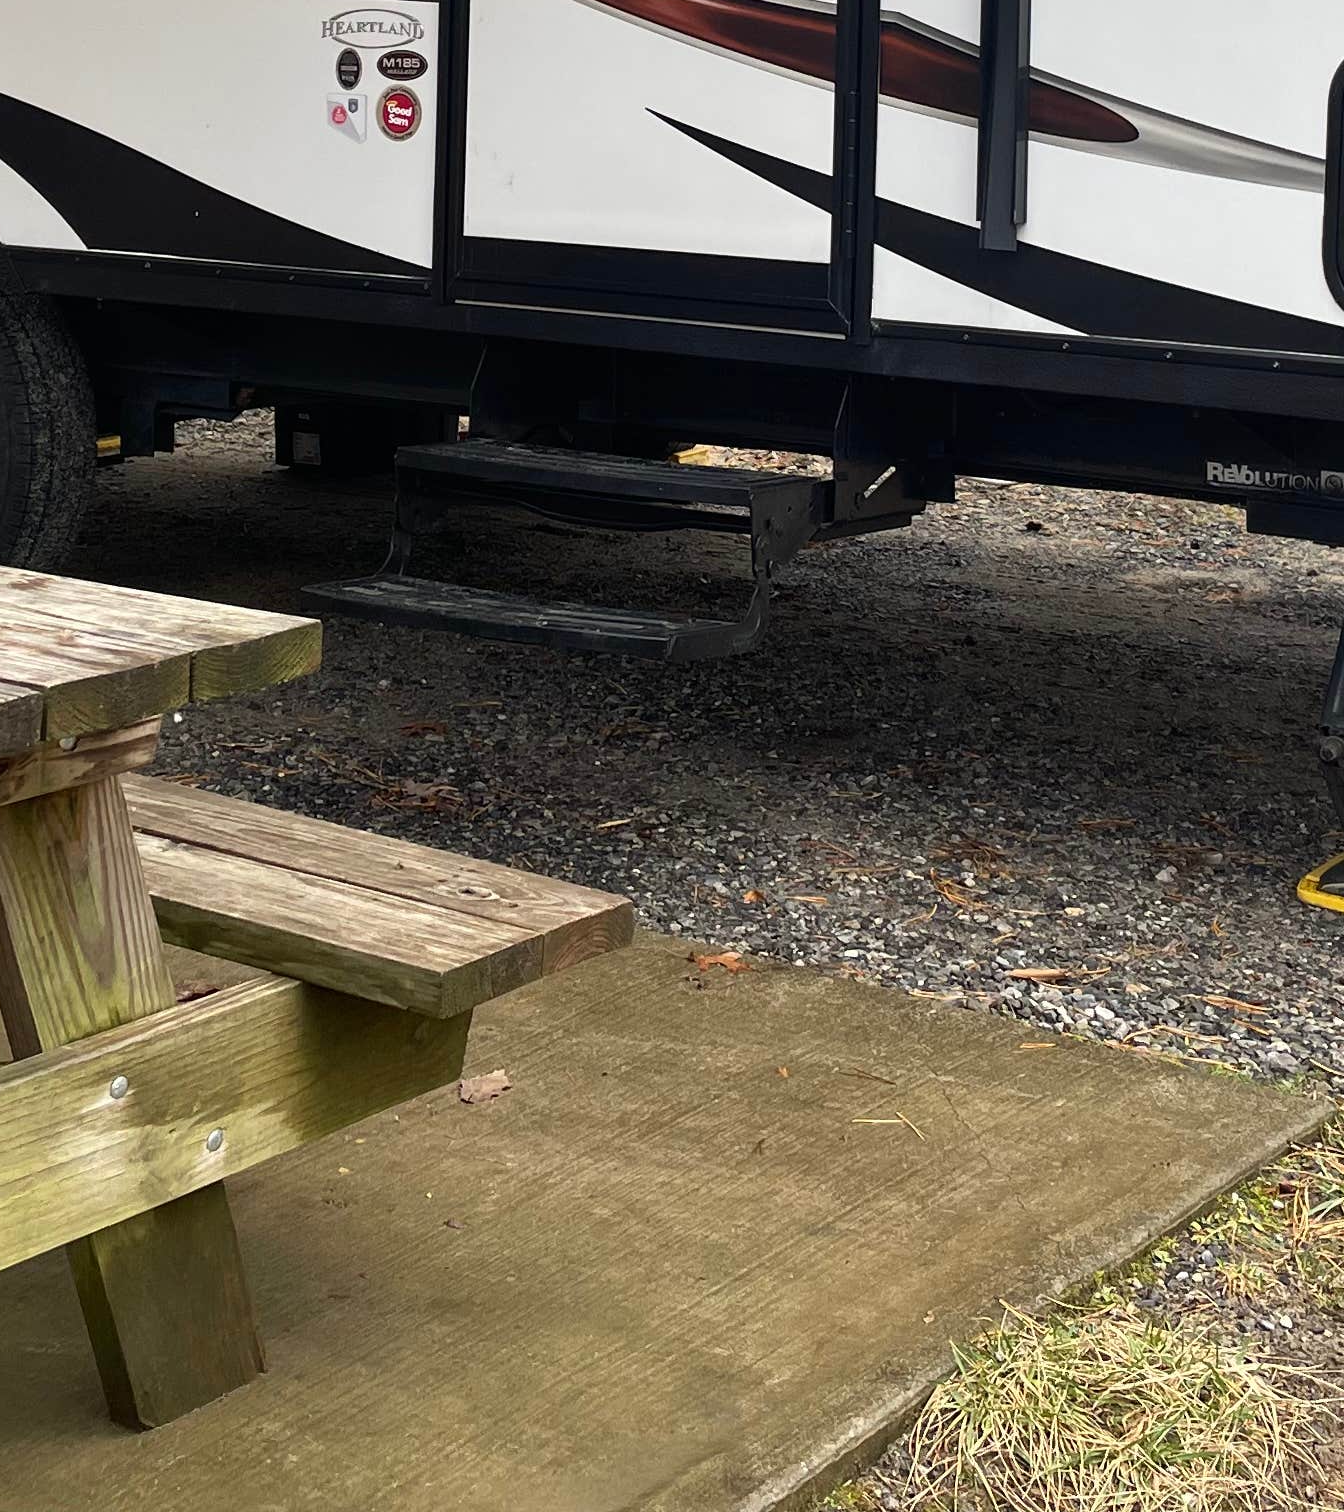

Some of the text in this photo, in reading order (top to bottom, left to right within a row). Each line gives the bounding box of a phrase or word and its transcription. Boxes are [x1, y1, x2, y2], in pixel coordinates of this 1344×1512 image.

[321, 20, 425, 39] HEARTLAND
[382, 57, 421, 68] M185
[387, 104, 413, 117] Good
[388, 114, 409, 126] Sam
